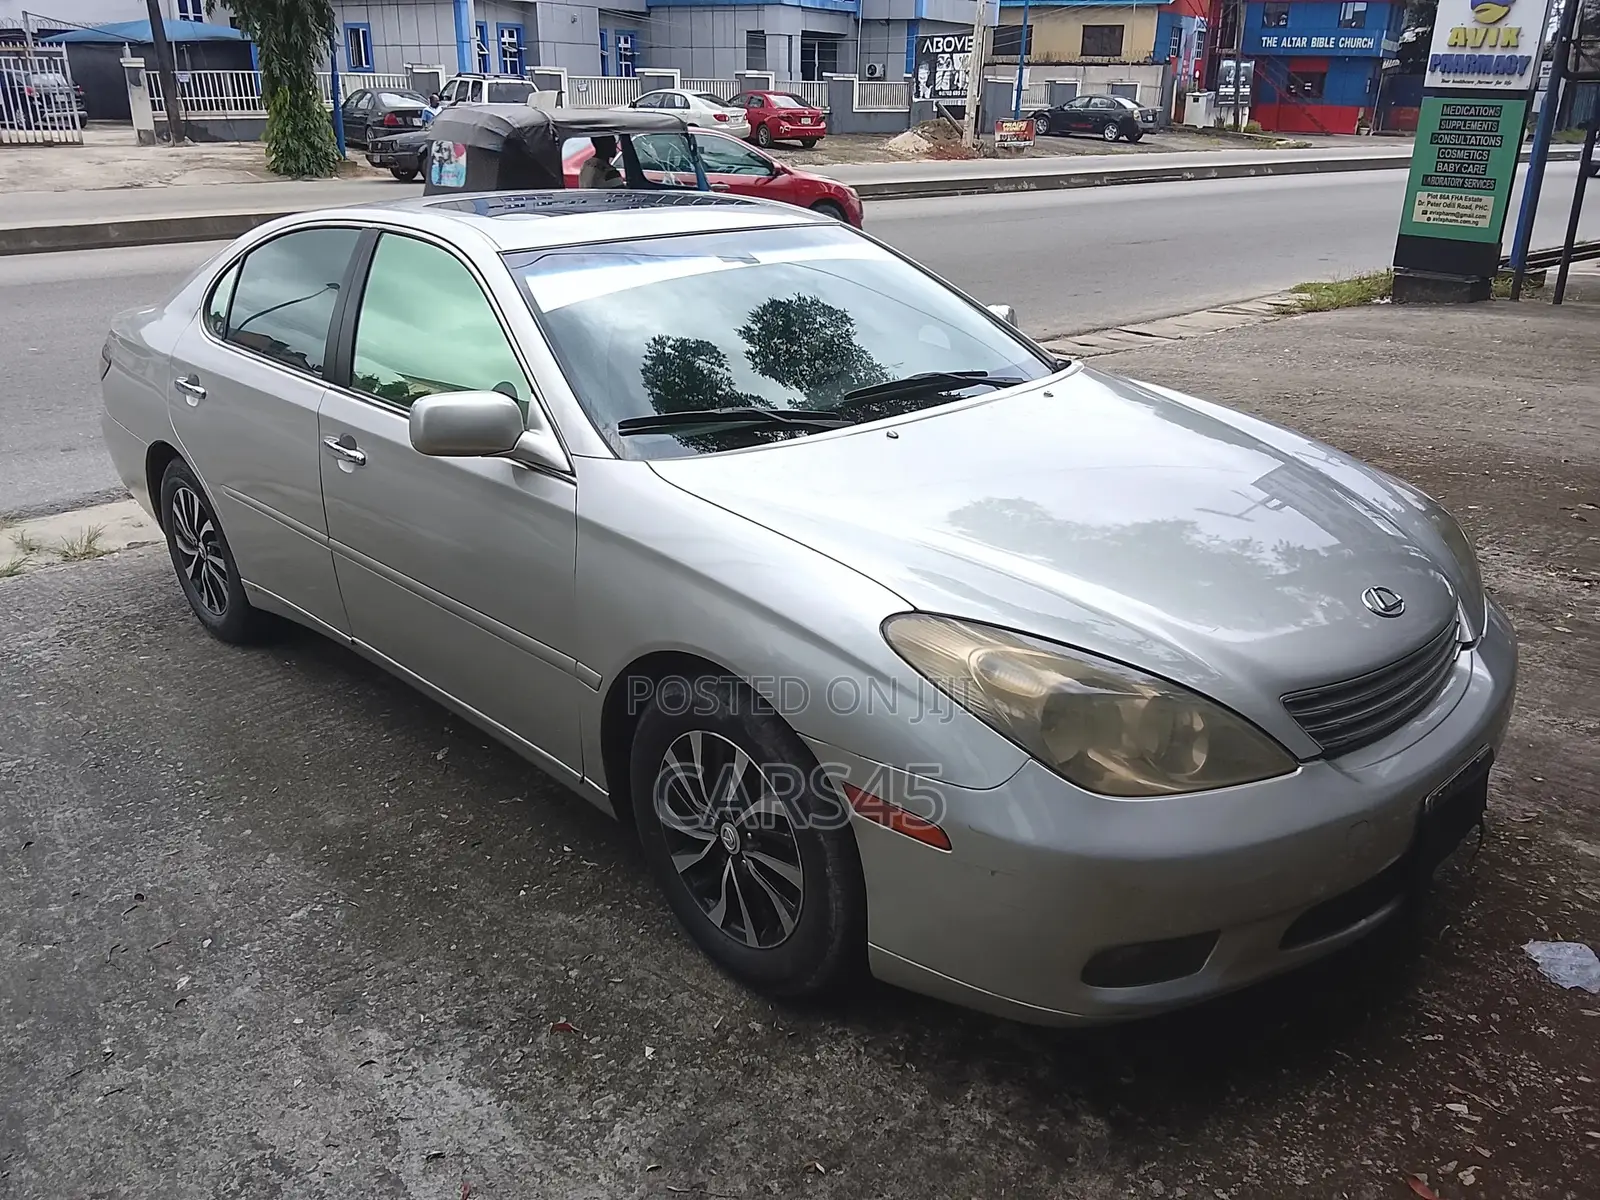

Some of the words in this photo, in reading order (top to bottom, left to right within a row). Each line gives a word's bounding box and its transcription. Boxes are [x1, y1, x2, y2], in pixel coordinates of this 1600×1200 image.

[1261, 36, 1277, 48] THE
[1281, 36, 1307, 48] ALTAR
[1311, 37, 1335, 48] BIBLE
[1339, 37, 1374, 49] CHURCH
[1429, 53, 1532, 76] PHARMACY
[1442, 105, 1501, 117] MEDICATIONS
[1440, 120, 1498, 131] SUPPLEMENTS
[1432, 134, 1502, 146] CONSULTATIONS
[1439, 148, 1489, 160] COSMETICS
[1436, 162, 1460, 173] BABY
[1462, 164, 1486, 174] CARE
[1423, 176, 1463, 187] LABORATORY
[1464, 178, 1495, 189] SERVICES
